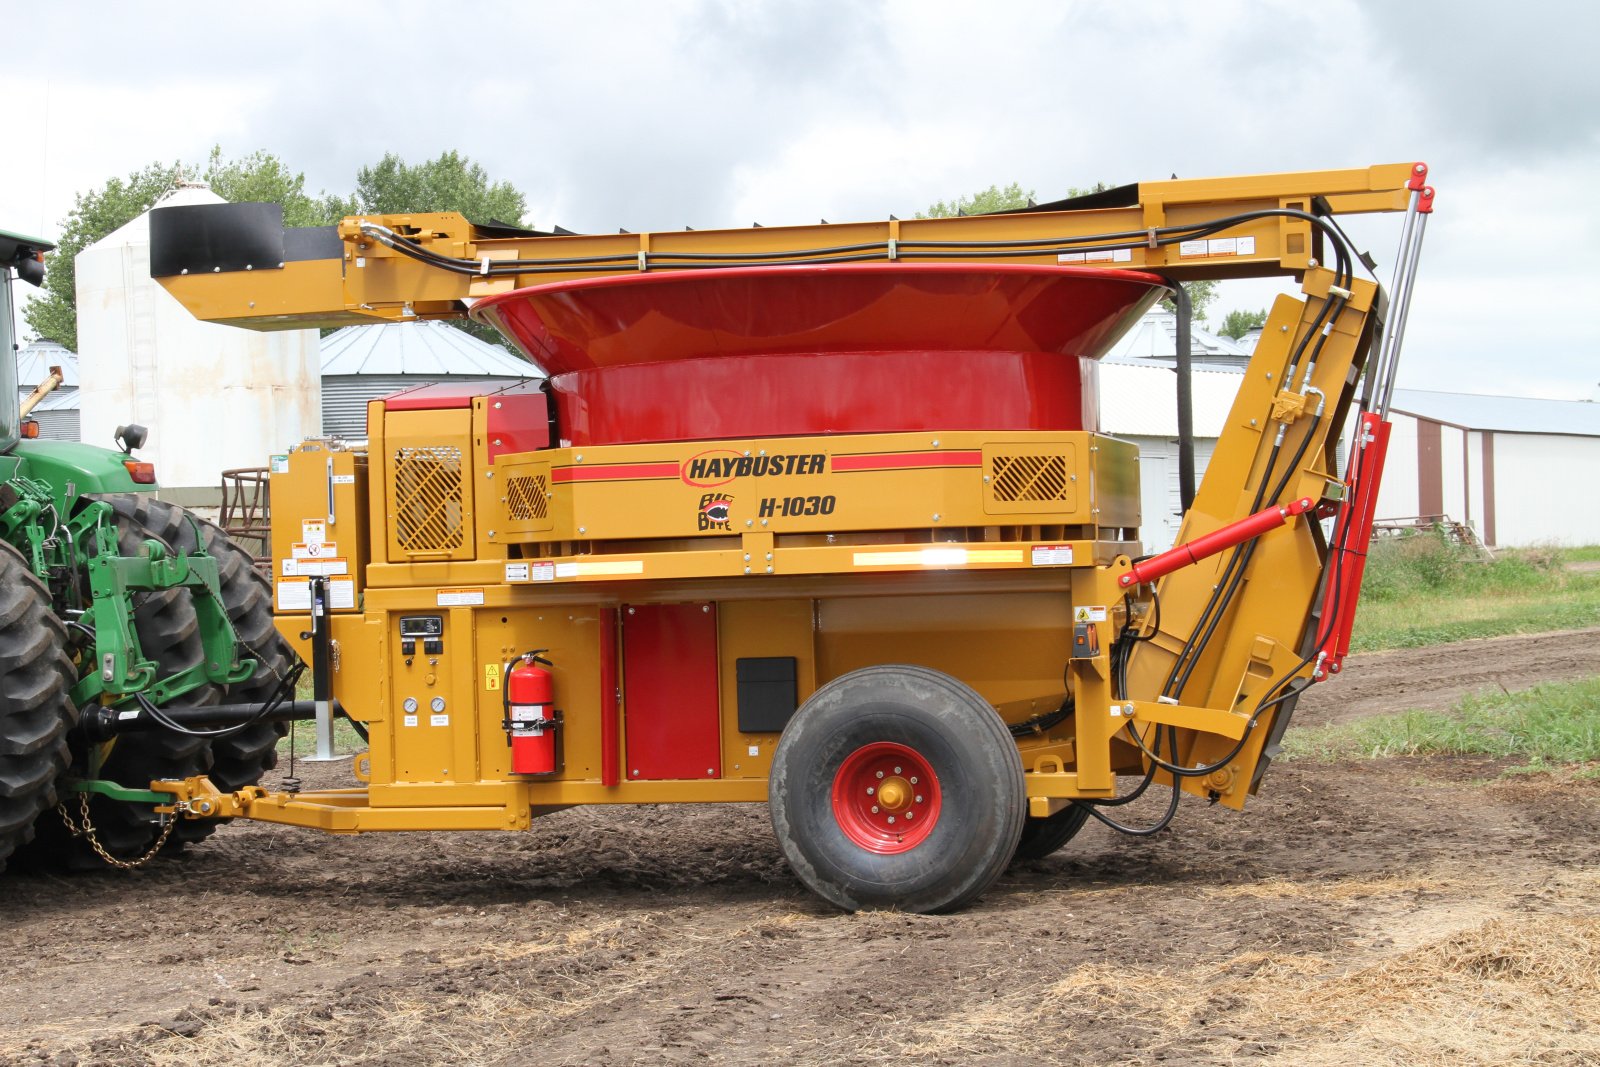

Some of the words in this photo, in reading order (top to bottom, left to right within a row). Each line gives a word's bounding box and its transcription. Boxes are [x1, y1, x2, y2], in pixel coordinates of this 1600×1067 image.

[689, 454, 826, 479] HAYBUSTER
[699, 493, 735, 510] BIG
[758, 495, 836, 518] H-1030
[698, 512, 732, 531] BITE
